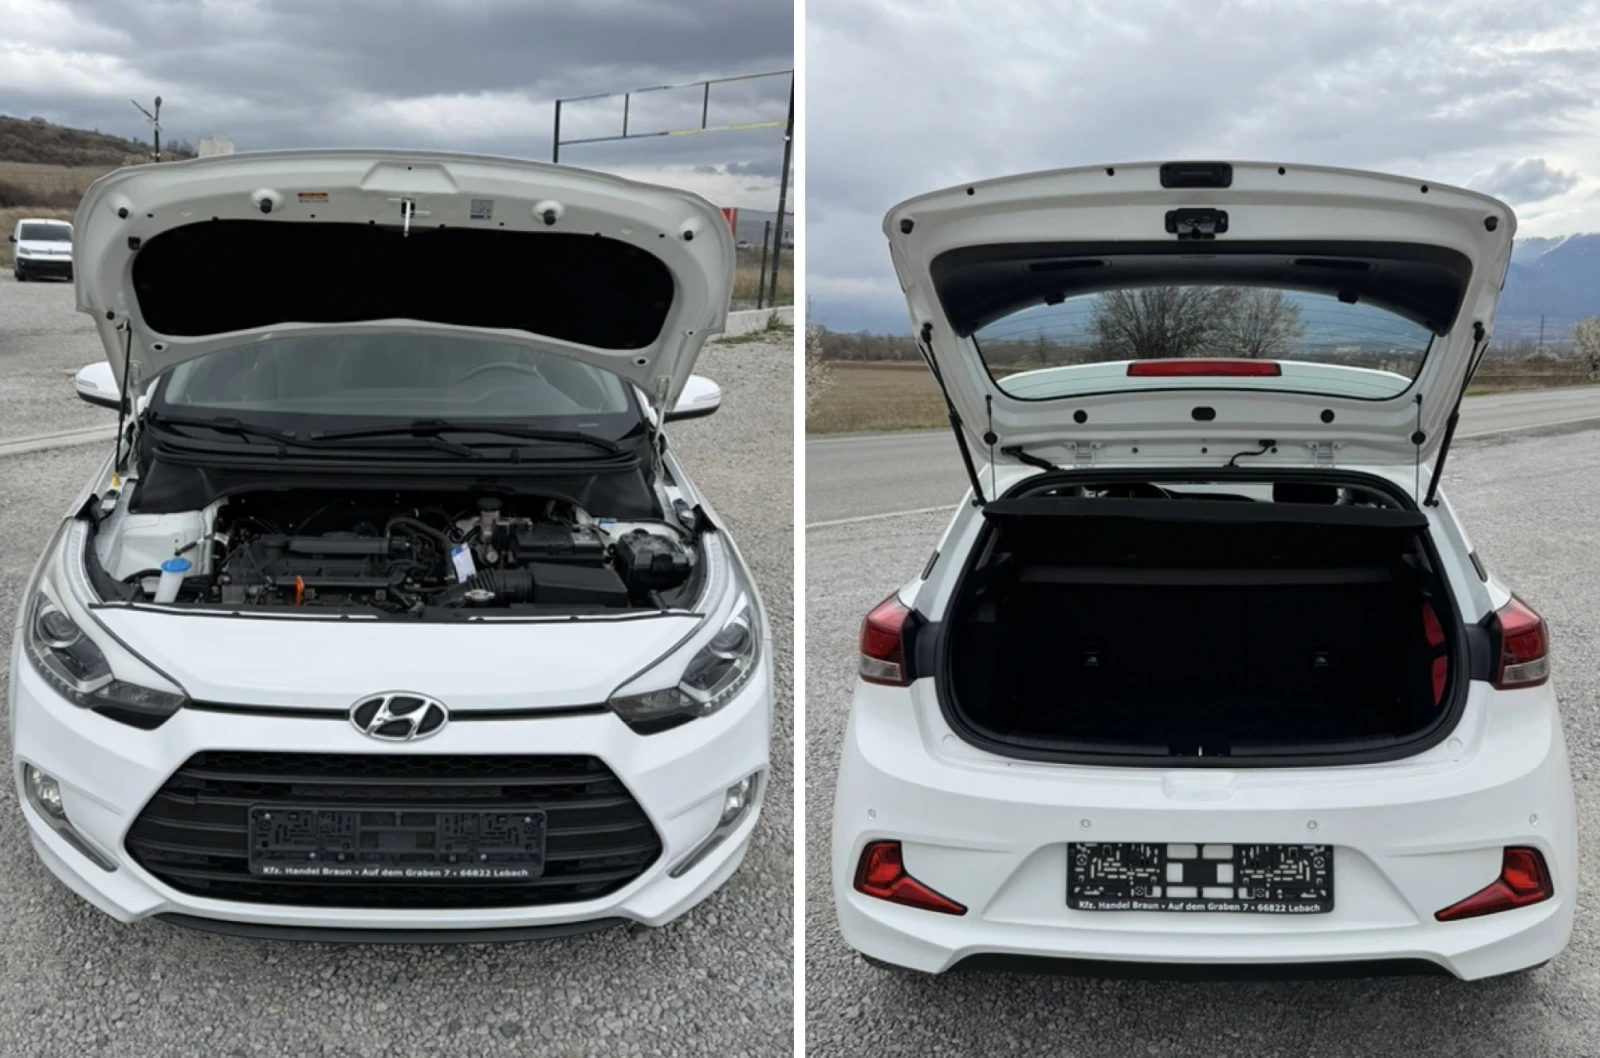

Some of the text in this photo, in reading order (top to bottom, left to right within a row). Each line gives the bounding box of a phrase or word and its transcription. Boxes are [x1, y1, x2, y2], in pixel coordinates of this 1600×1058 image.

[263, 866, 528, 877] Kfz. Handel Braun Auf dem Graben 7 66822 Lebach
[1079, 900, 1320, 912] Kfz. Handel Braun Auf dem Graben 7 66822 Lebach
